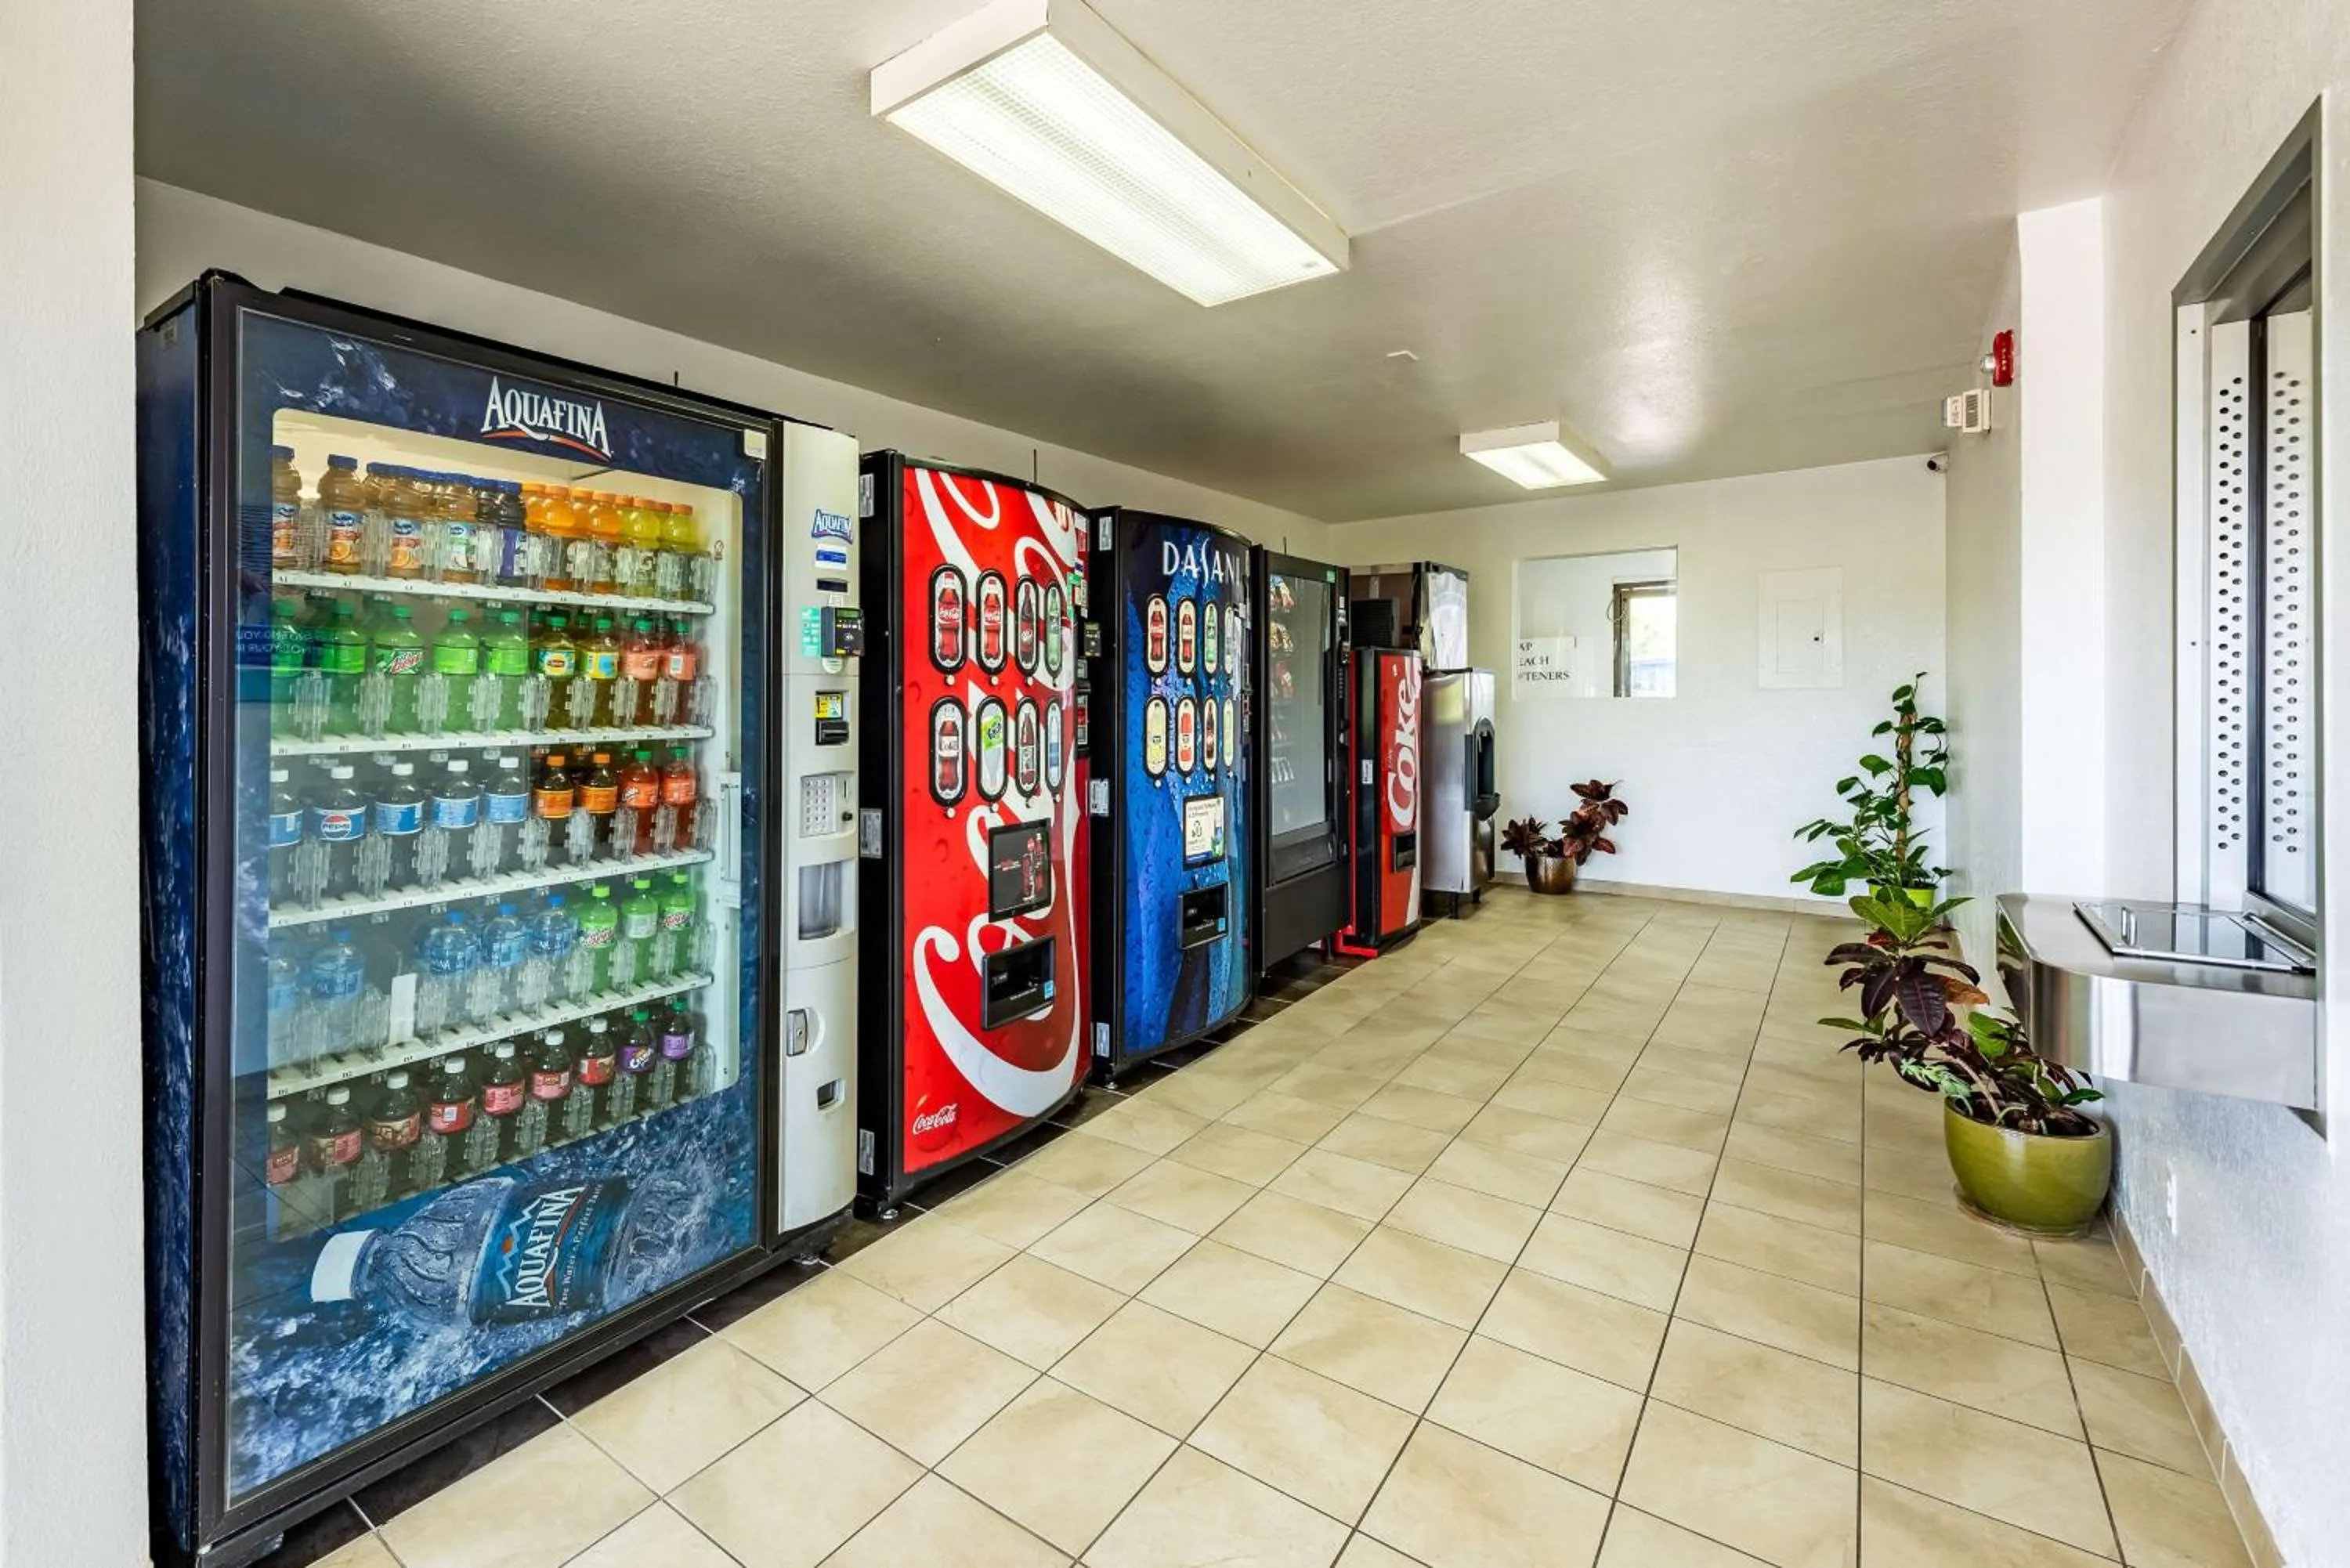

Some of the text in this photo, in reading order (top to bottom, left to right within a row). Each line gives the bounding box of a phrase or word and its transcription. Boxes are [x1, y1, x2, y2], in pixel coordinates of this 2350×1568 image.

[481, 375, 613, 458] AQUAFINA
[1162, 537, 1241, 589] DASANI
[1387, 678, 1416, 826] Coke
[505, 1186, 586, 1308] AQUAFINA
